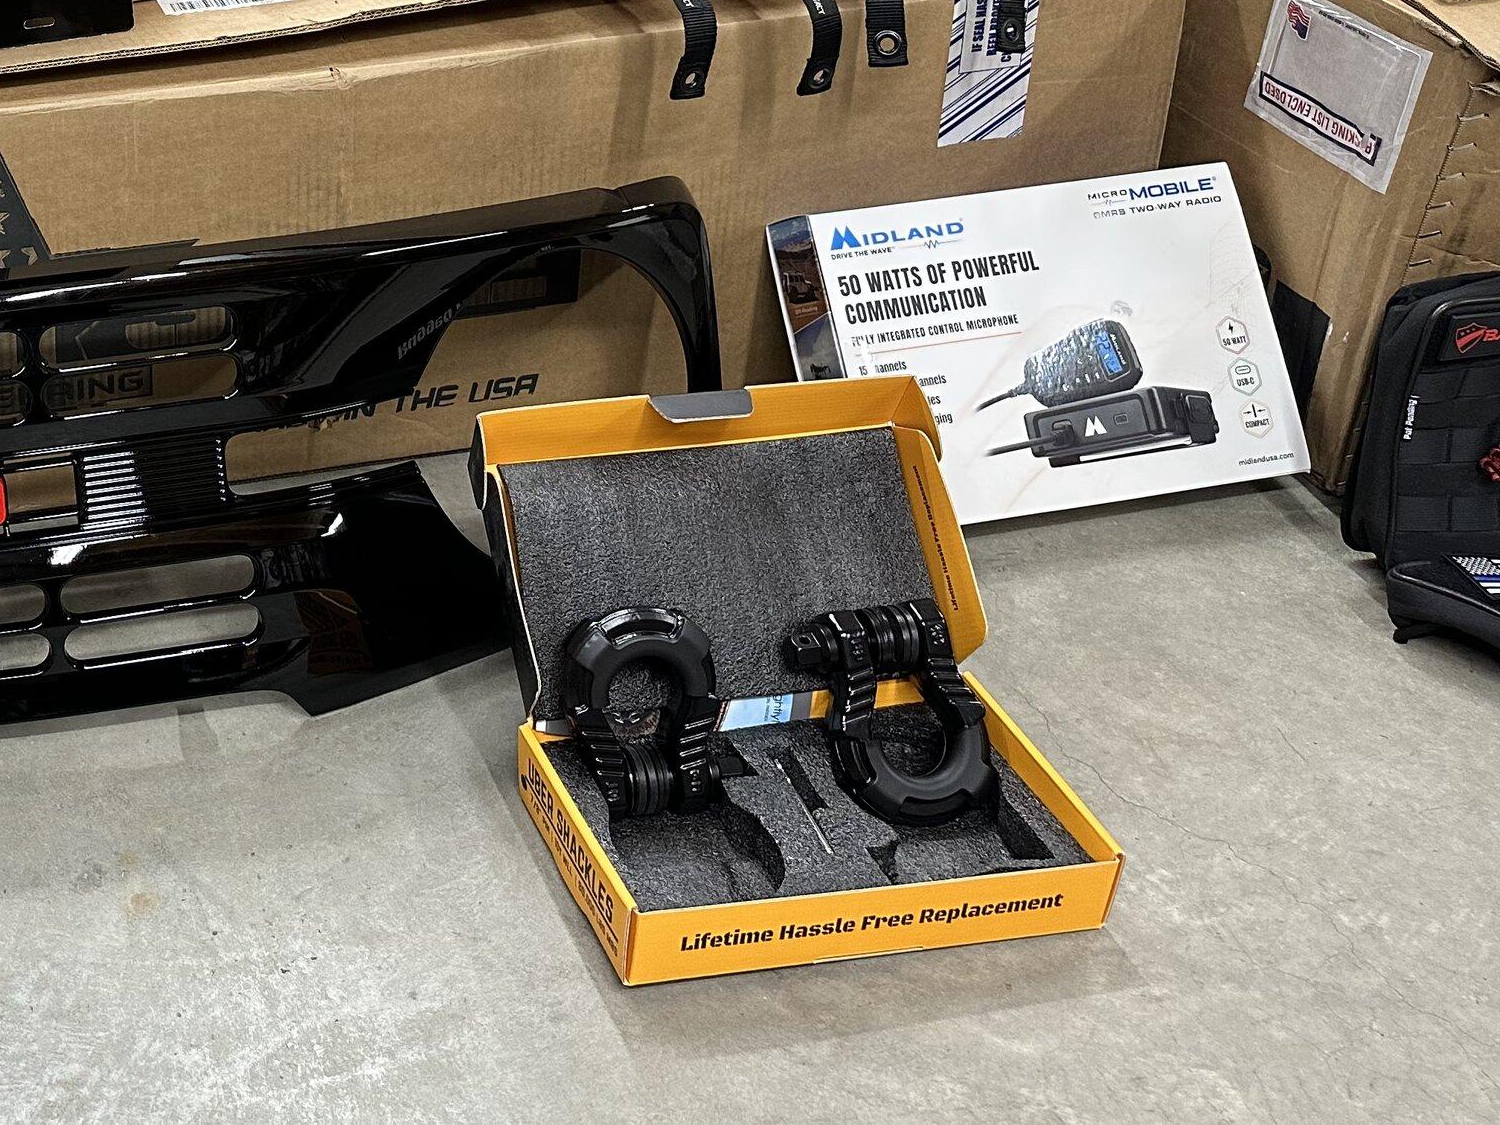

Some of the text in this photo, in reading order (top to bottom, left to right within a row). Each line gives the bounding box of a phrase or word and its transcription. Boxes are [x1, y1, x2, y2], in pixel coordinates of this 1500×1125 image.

[972, 14, 986, 40] SEAL
[971, 40, 984, 54] IF
[1264, 81, 1373, 155] PCKING LIST ENCLOSED
[1088, 177, 1214, 201] MICRO MOBILE
[1130, 200, 1182, 215] TWO-WAY
[1185, 195, 1222, 207] RADIO
[830, 220, 965, 251] MIDLAND
[831, 247, 893, 260] DRIVE THE WAVE
[837, 250, 1040, 297] 50 WATTS OF POWERFUL
[844, 285, 987, 325] COMMUNICATION
[877, 326, 926, 344] INTEGRATED
[928, 322, 965, 337] CONTROL
[966, 313, 1019, 332] MICROPHONE
[1231, 335, 1247, 345] WATT
[468, 373, 540, 404] USA
[1236, 376, 1255, 387] USB-C
[1244, 418, 1270, 429] COMPACT
[1238, 451, 1295, 466] midlandusa.com
[936, 543, 948, 574] Hassle
[945, 574, 959, 611] Lifetime
[527, 758, 614, 924] UBER SHACKLES
[680, 893, 1064, 952] Lifetime Hassle Free Replacement
